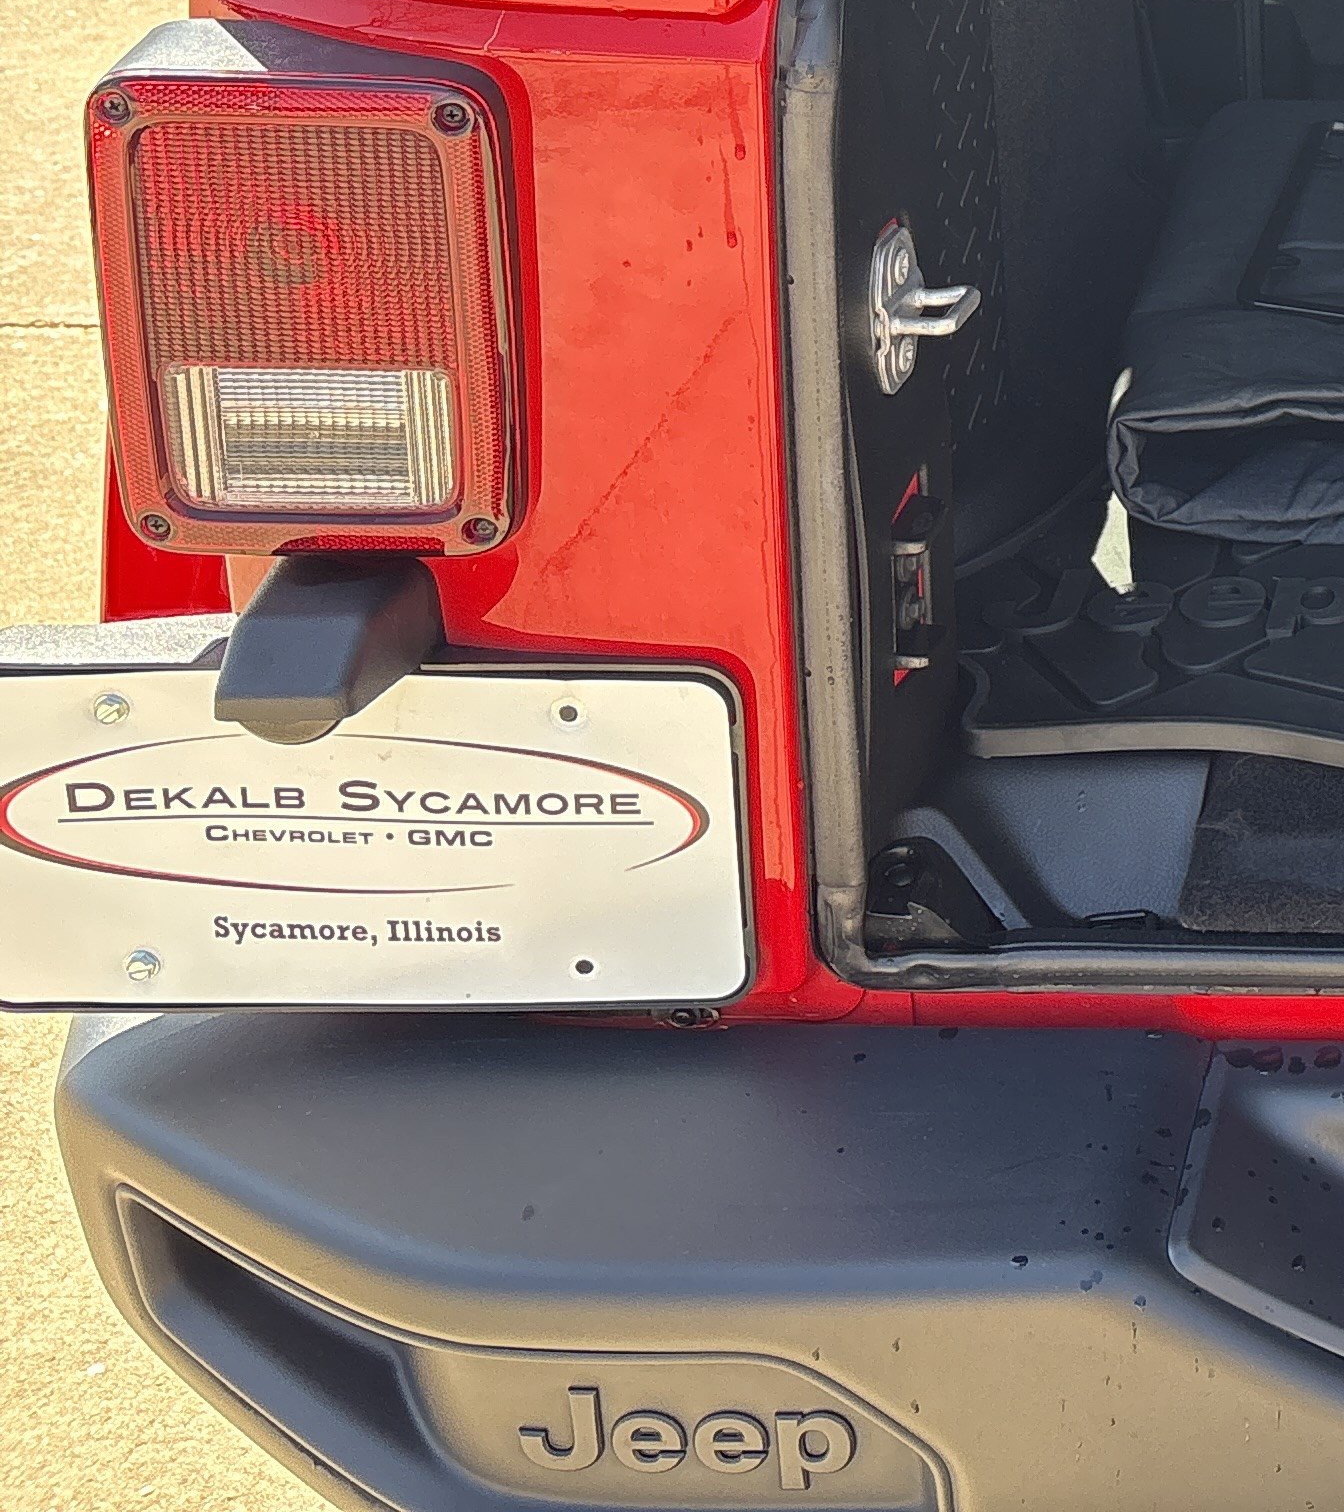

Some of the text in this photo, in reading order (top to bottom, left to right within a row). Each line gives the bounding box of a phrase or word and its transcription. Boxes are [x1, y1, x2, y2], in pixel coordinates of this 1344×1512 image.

[338, 779, 642, 816] SYCAMORE
[205, 824, 493, 847] CHEVROLET GMC
[213, 915, 502, 947] Sycamore, Illinois
[518, 1385, 858, 1490] Jeep
